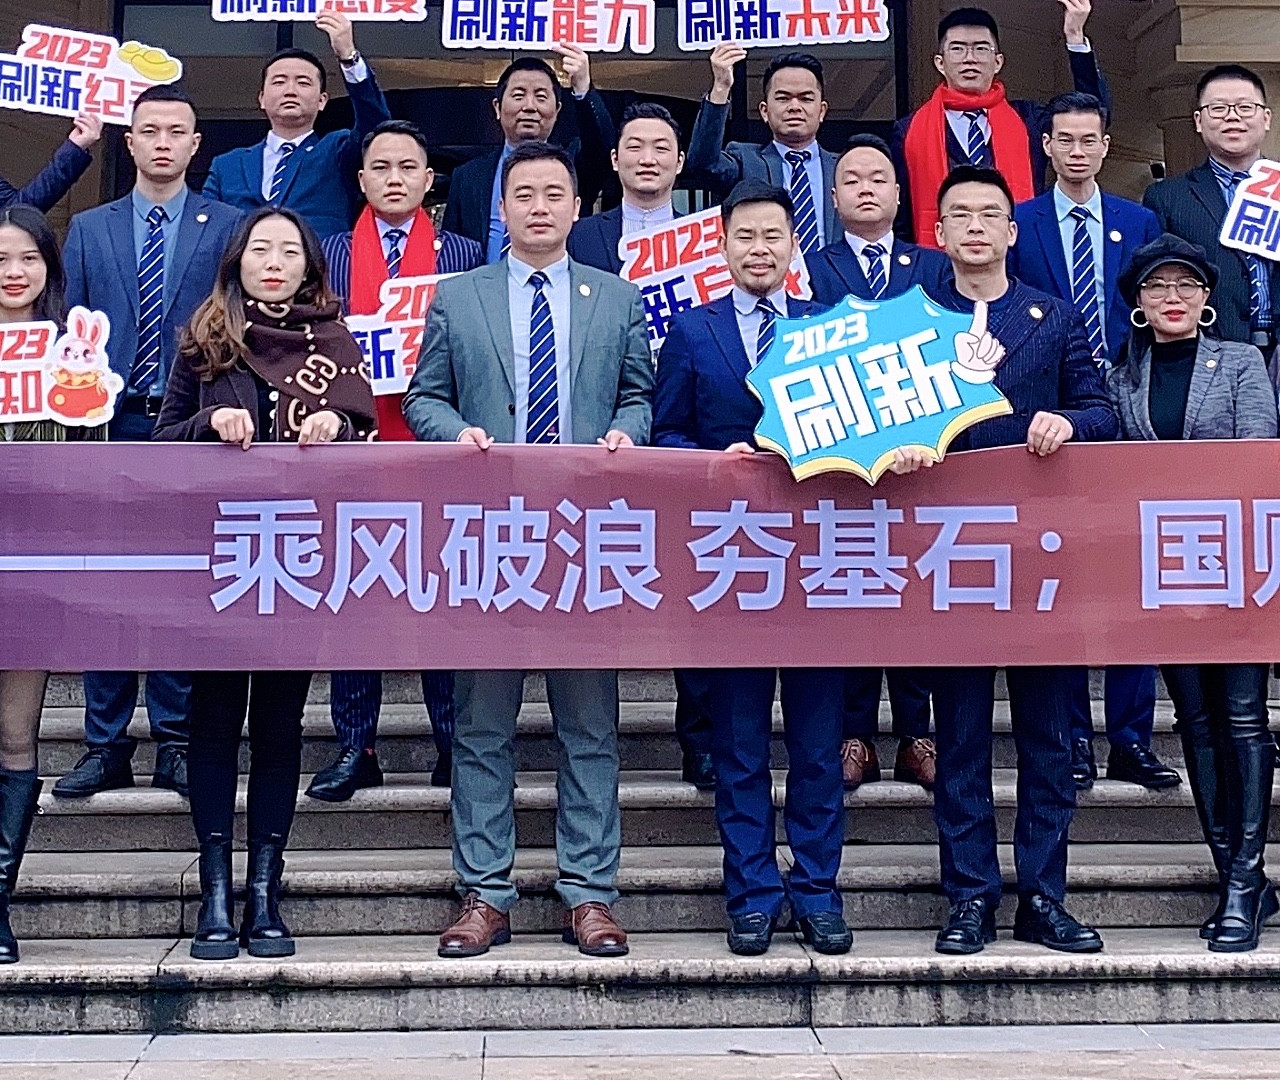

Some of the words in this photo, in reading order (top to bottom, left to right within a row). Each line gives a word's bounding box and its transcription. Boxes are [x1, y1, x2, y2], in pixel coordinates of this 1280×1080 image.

[24, 31, 112, 69] 2023
[385, 283, 438, 322] 20
[782, 311, 869, 365] 2023
[769, 328, 965, 457] 刷新
